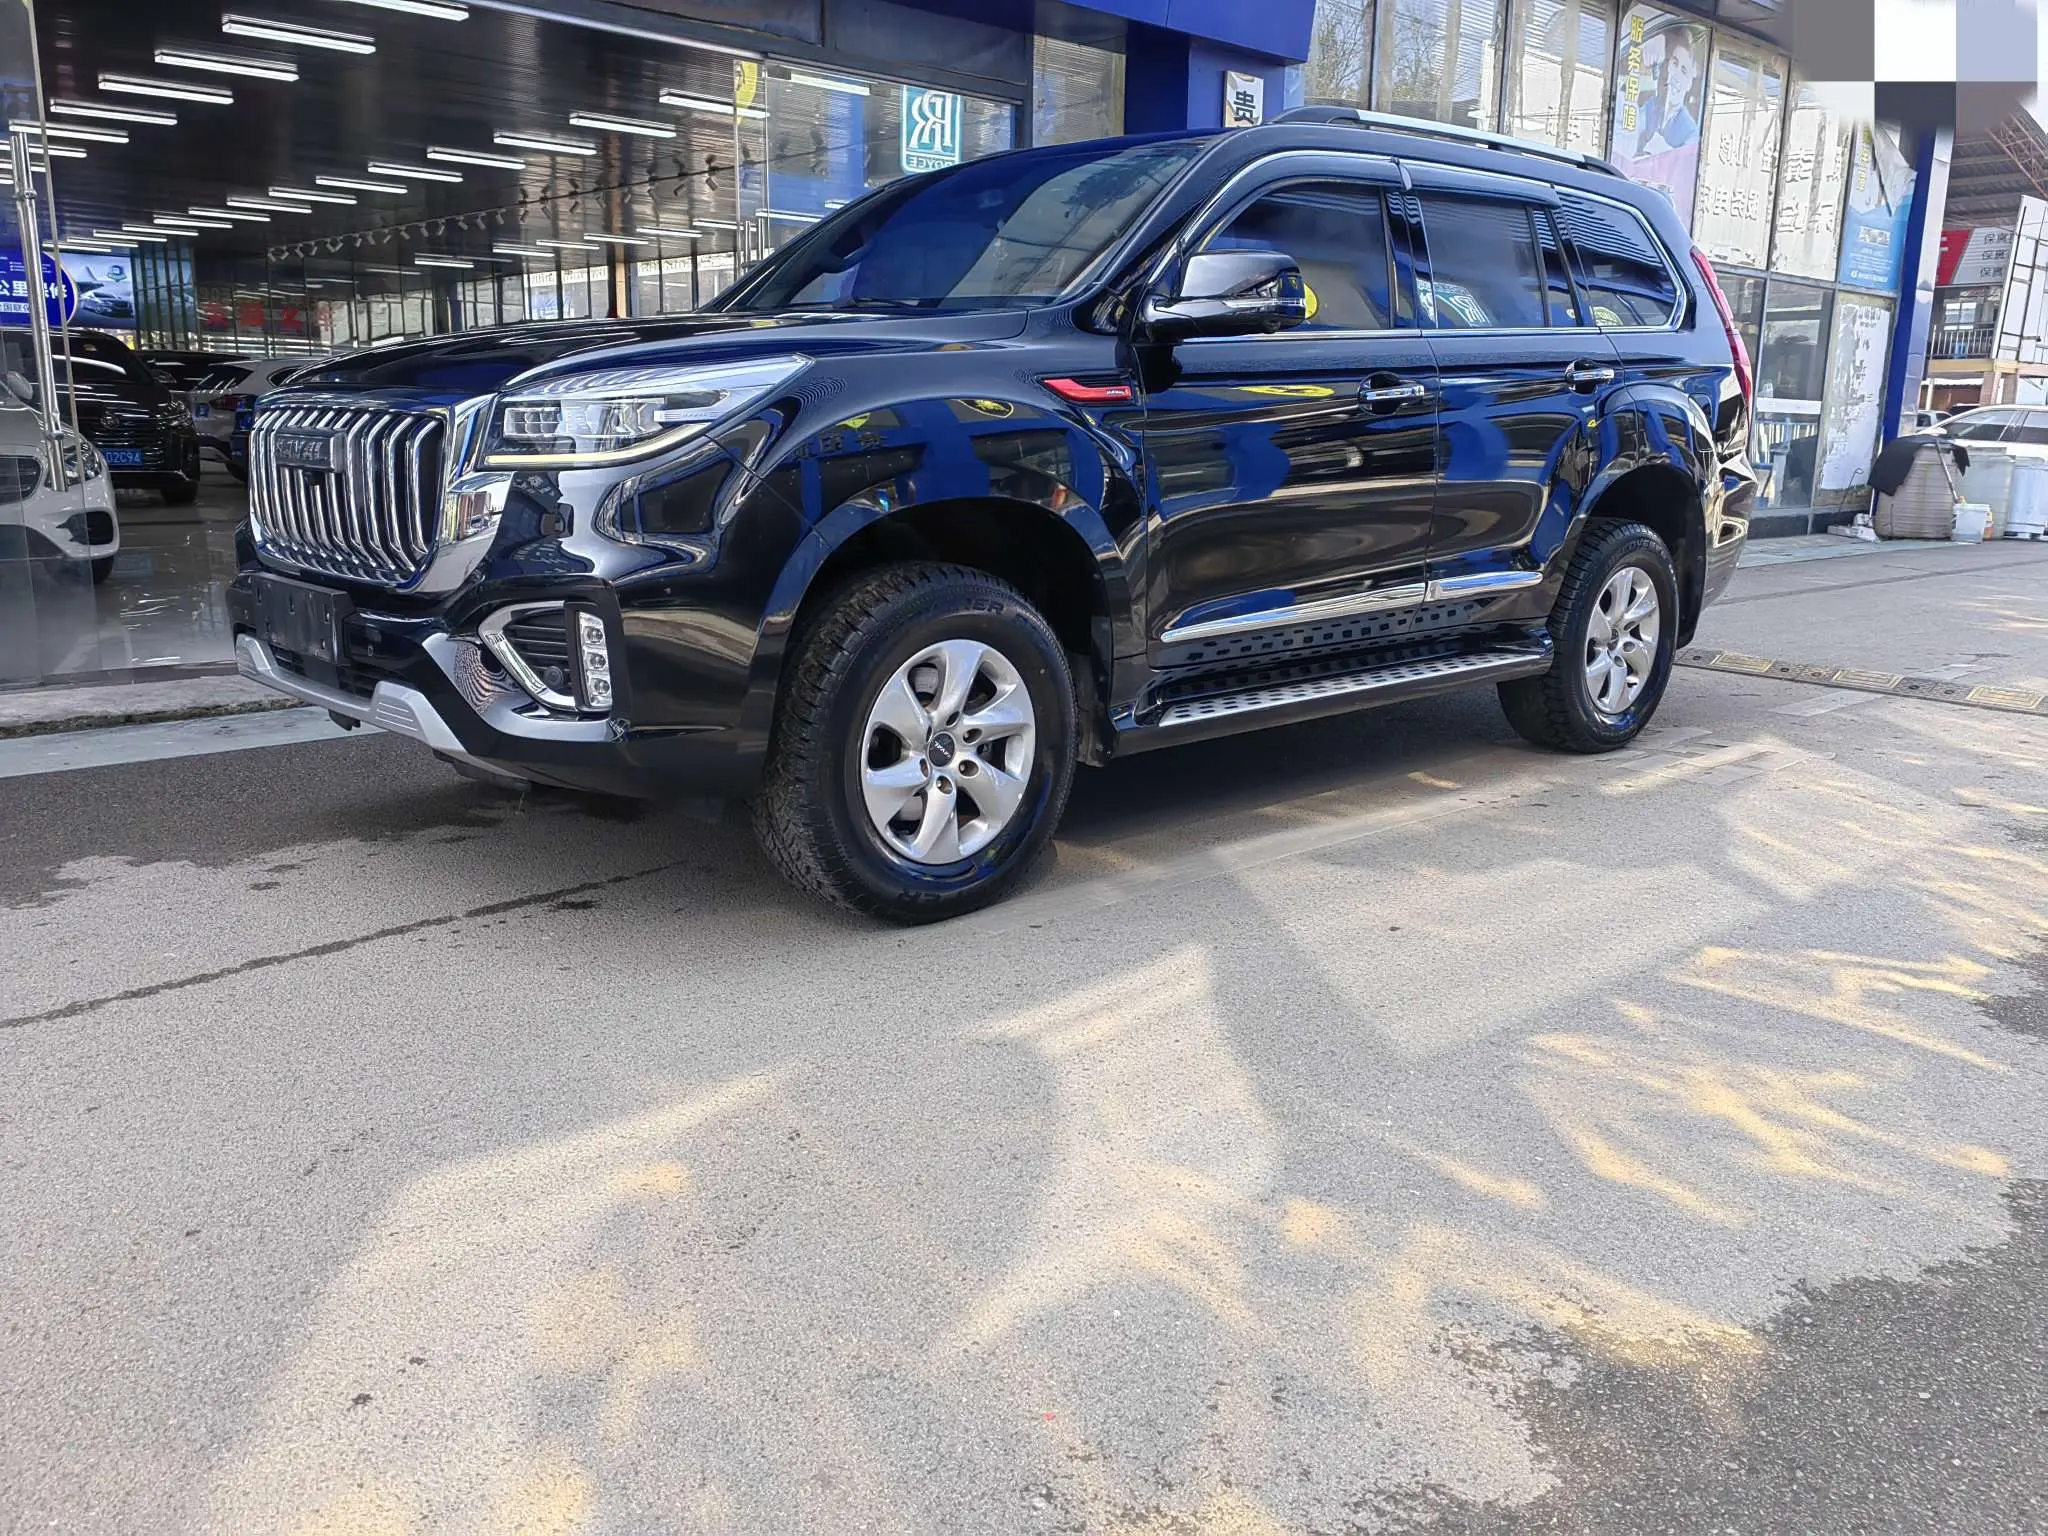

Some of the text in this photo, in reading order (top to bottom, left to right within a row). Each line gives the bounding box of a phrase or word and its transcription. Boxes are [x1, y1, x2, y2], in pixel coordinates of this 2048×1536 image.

[1233, 90, 1256, 125] 贵
[1623, 15, 1644, 131] 服务保障
